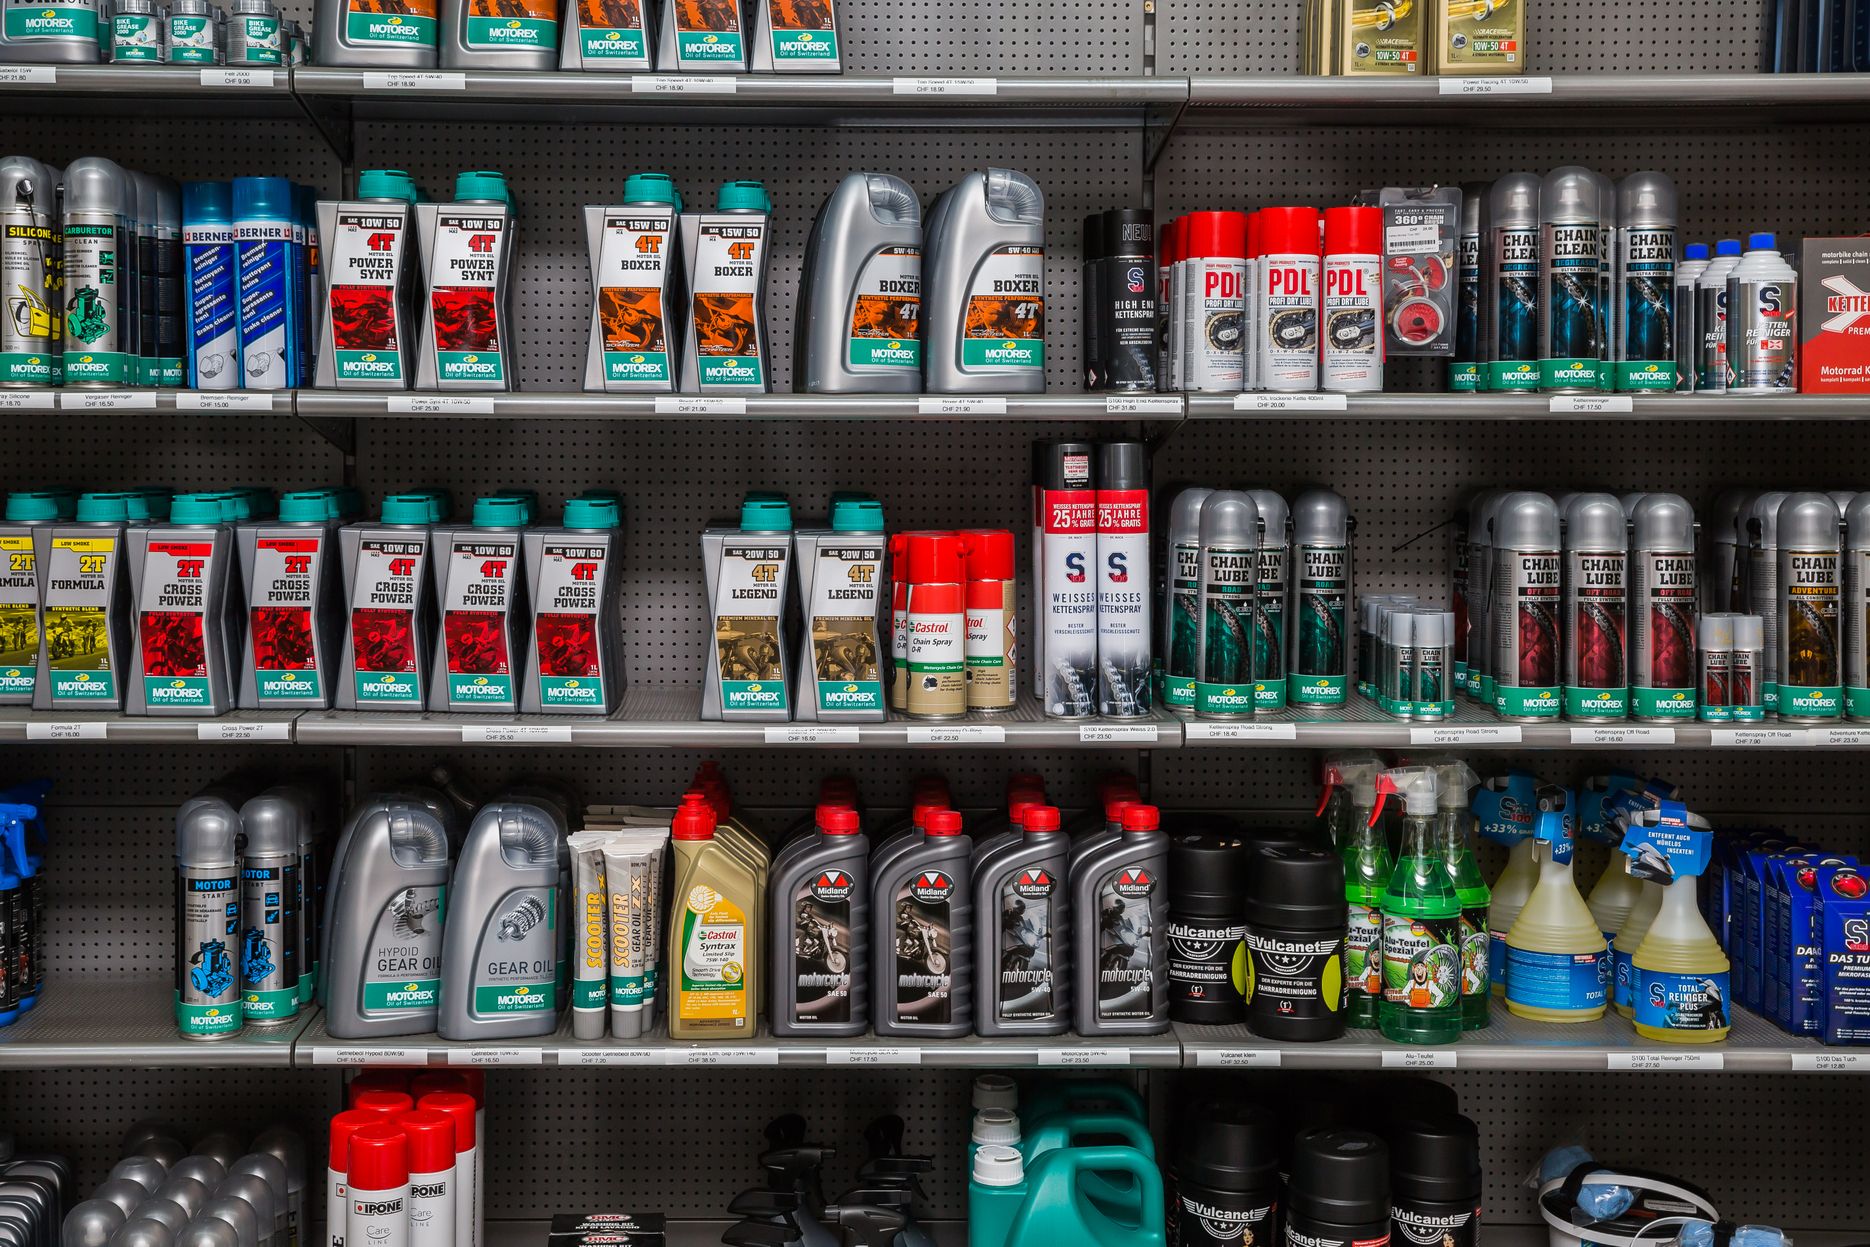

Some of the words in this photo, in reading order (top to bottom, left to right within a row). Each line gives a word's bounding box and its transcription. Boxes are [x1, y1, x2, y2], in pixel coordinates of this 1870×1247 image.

[26, 19, 74, 28] MOTOREX
[370, 24, 419, 35] MOTOREX
[588, 41, 637, 50] MOTOREX
[780, 42, 829, 51] MOTOREX
[1376, 51, 1400, 60] 10W-50
[1401, 51, 1410, 60] 4T
[9, 226, 51, 238] SILICONE
[65, 227, 113, 235] CARBURETOR
[240, 228, 280, 238] BERNER
[1555, 230, 1597, 242] CHAIN
[1630, 235, 1672, 246] CHAIN
[1555, 244, 1597, 255] CLEAN
[1630, 248, 1672, 260] CLEAN
[349, 258, 393, 267] POWER
[621, 260, 661, 270] BOXER
[242, 262, 272, 282] Nettoyant
[360, 270, 393, 280] SYNT
[714, 266, 753, 277] BOXER
[994, 280, 1039, 292] BOXER
[1269, 269, 1310, 295] PDL
[1327, 269, 1367, 295] PDL
[1014, 304, 1038, 319] 4T
[243, 320, 260, 334] Brake
[259, 307, 283, 326] cleaner
[985, 349, 1032, 358] MOTOREX
[68, 363, 109, 372] MOTOREX
[344, 362, 394, 372] MOTOREX
[1821, 366, 1862, 375] Motorrad
[1555, 370, 1595, 378] MOTOREX
[1113, 509, 1140, 518] JAHRE
[1121, 519, 1141, 527] GRATIS
[80, 556, 106, 572] 2T
[389, 559, 415, 576] 4T
[1211, 557, 1252, 568] CHAIN
[1582, 559, 1624, 571] CHAIN
[1792, 558, 1836, 570] CHAIN
[752, 564, 779, 582] 4T
[1215, 570, 1248, 582] LUBE
[1797, 571, 1833, 583] LUBE
[1586, 573, 1621, 585] LUBE
[51, 580, 104, 590] FORMULA
[164, 584, 202, 595] CROSS
[376, 582, 413, 593] CROSS
[371, 593, 413, 603] POWER
[732, 589, 777, 599] LEGEND
[828, 590, 873, 600] LEGEND
[1053, 593, 1095, 602] WEISSES
[159, 596, 202, 606] POWER
[916, 623, 949, 633] Castrol
[932, 638, 952, 646] Spray
[58, 682, 106, 690] MOTOREX
[363, 683, 411, 692] MOTOREX
[1208, 695, 1248, 704] MOTOREX
[1582, 700, 1622, 708] MOTOREX
[1793, 698, 1836, 706] MOTOREX
[1648, 832, 1674, 840] ENTFERNT
[1666, 847, 1694, 855] INSEKTEN!
[195, 880, 230, 889] MOTOR
[613, 893, 629, 968] SCOOTER
[1169, 922, 1231, 938] Vulcanet
[707, 931, 736, 940] Castrol
[1256, 937, 1320, 953] Vulcanet
[1385, 937, 1430, 948] Alu-Teufel
[378, 946, 418, 957] HYPOID
[1385, 945, 1414, 955] Spezial
[1830, 954, 1853, 962] DAS
[378, 958, 417, 971] GEAR
[488, 962, 526, 975] GEAR
[533, 960, 552, 973] OIL
[798, 972, 849, 988] motorcycle
[1101, 969, 1151, 983] motorcycle
[1258, 984, 1317, 995] FAHRRADREINIGUNG
[1678, 984, 1699, 992] TOTAL
[498, 994, 544, 1004] MOTOREX
[1668, 993, 1707, 1002] REINIGER
[1680, 1003, 1698, 1011] PLUS
[191, 1014, 232, 1025] MOTOREX
[365, 1201, 401, 1214] IPONE
[1196, 1203, 1254, 1220] Vulcanet
[1394, 1207, 1454, 1225] Vulcanet
[367, 1226, 390, 1235] Care
